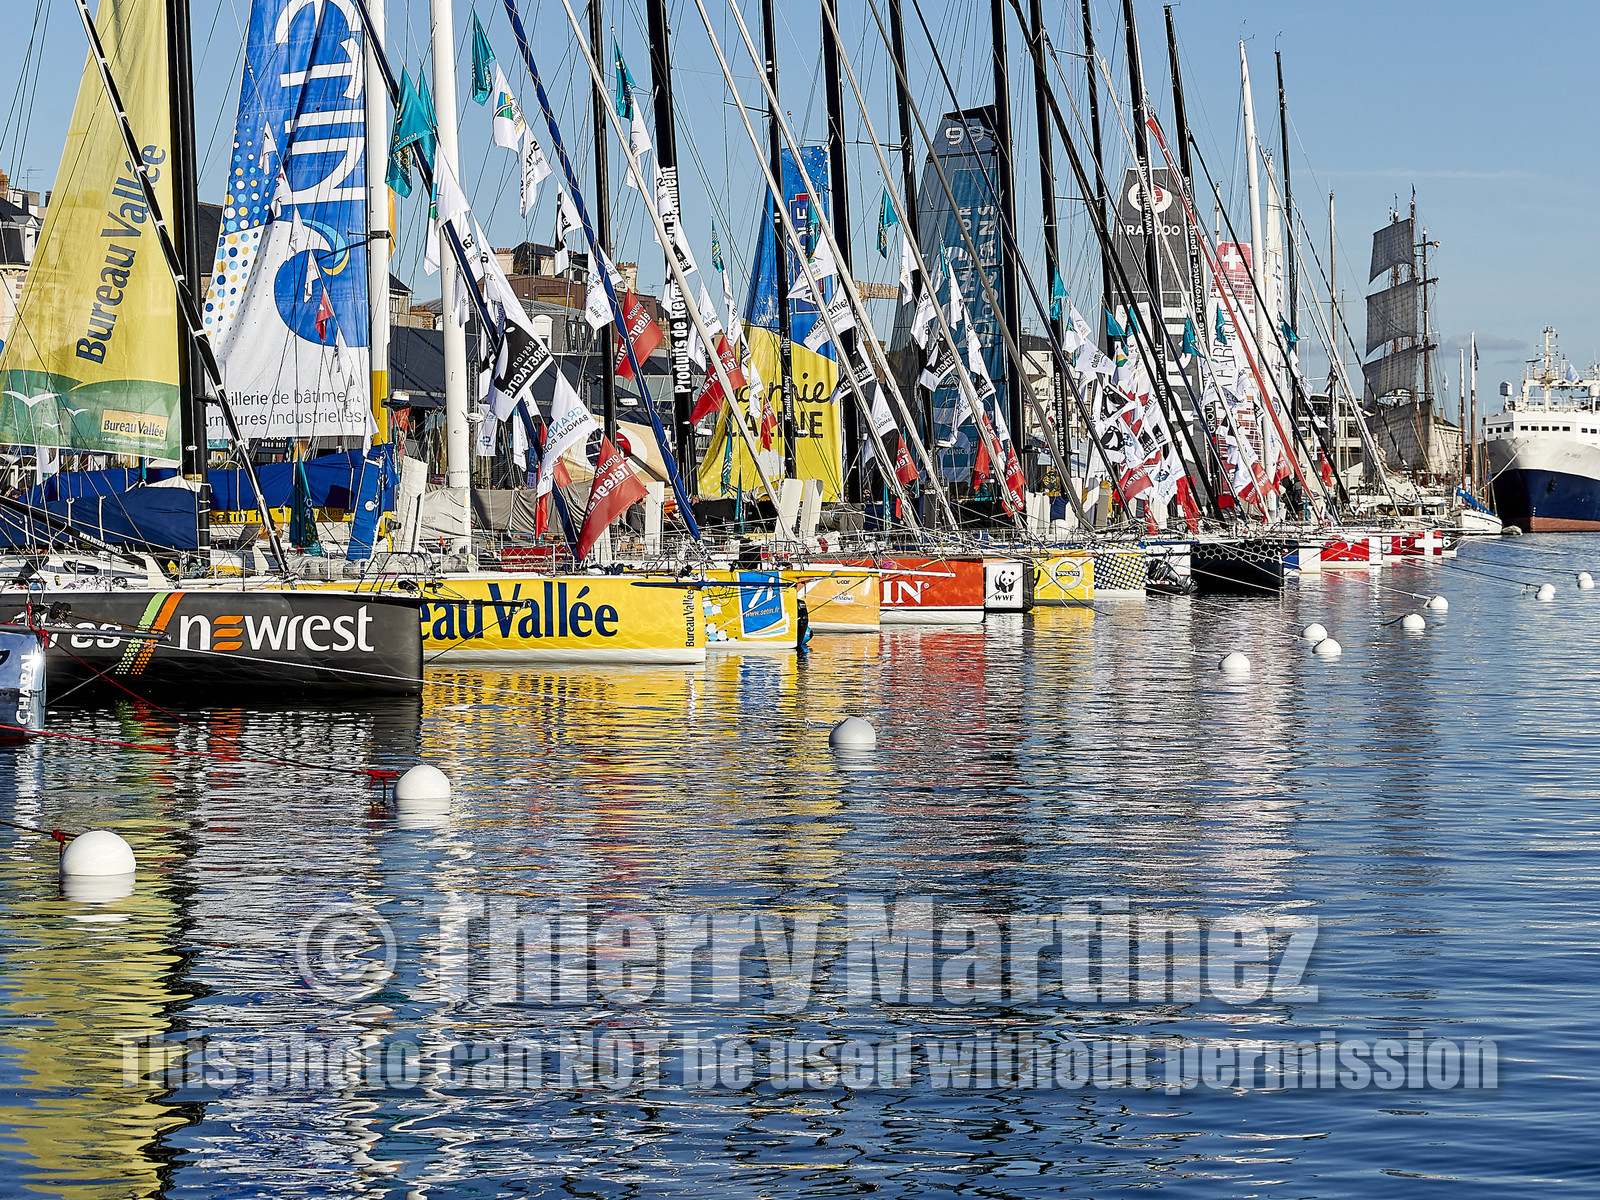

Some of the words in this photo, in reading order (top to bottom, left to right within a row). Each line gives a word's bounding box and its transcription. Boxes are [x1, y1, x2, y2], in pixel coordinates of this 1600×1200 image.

[75, 242, 137, 365] Bureau
[671, 319, 688, 338] de
[673, 340, 692, 395] Produits
[103, 419, 137, 434] Bureau
[138, 420, 165, 438] Vallée
[486, 581, 619, 638] Vallée
[682, 588, 695, 617] Vallée
[994, 593, 1014, 602] WWF
[685, 619, 695, 647] Bureau
